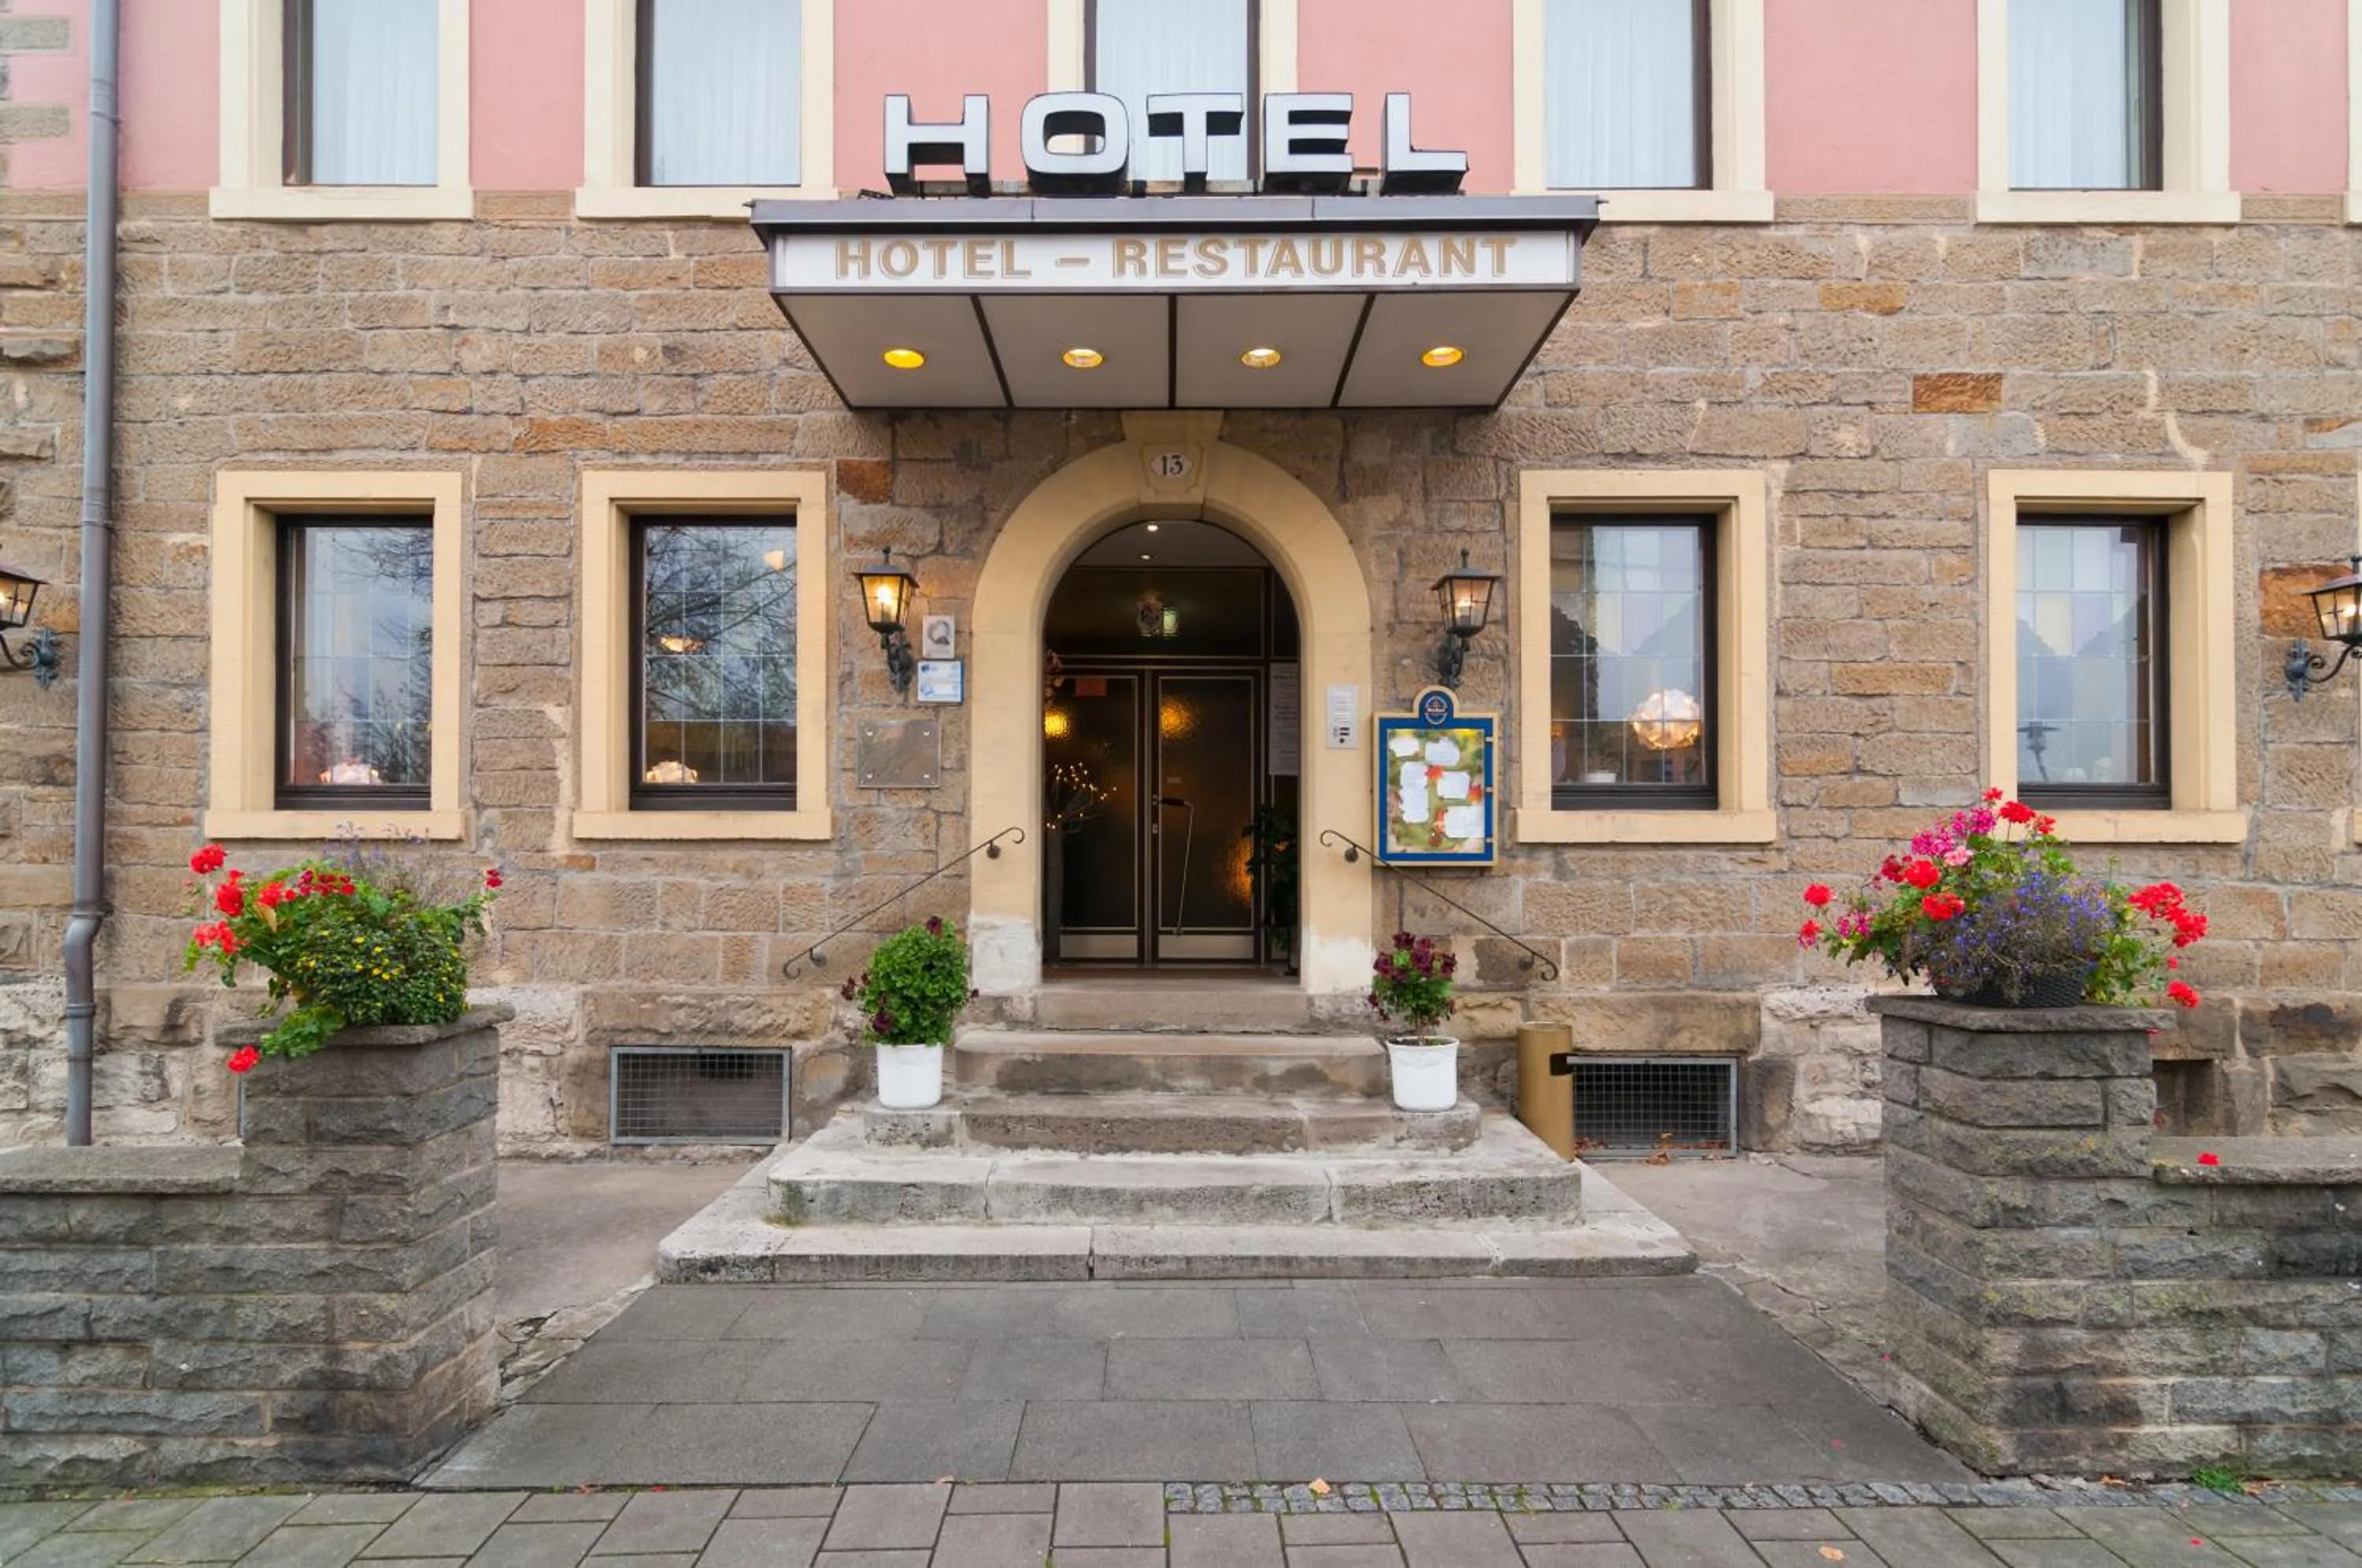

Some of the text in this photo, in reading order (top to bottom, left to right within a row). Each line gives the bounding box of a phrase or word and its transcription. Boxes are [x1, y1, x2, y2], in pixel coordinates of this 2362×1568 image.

[883, 92, 1469, 190] HOTEL
[835, 239, 1032, 279] HOTEL
[1112, 239, 1517, 279] RESTAURANT
